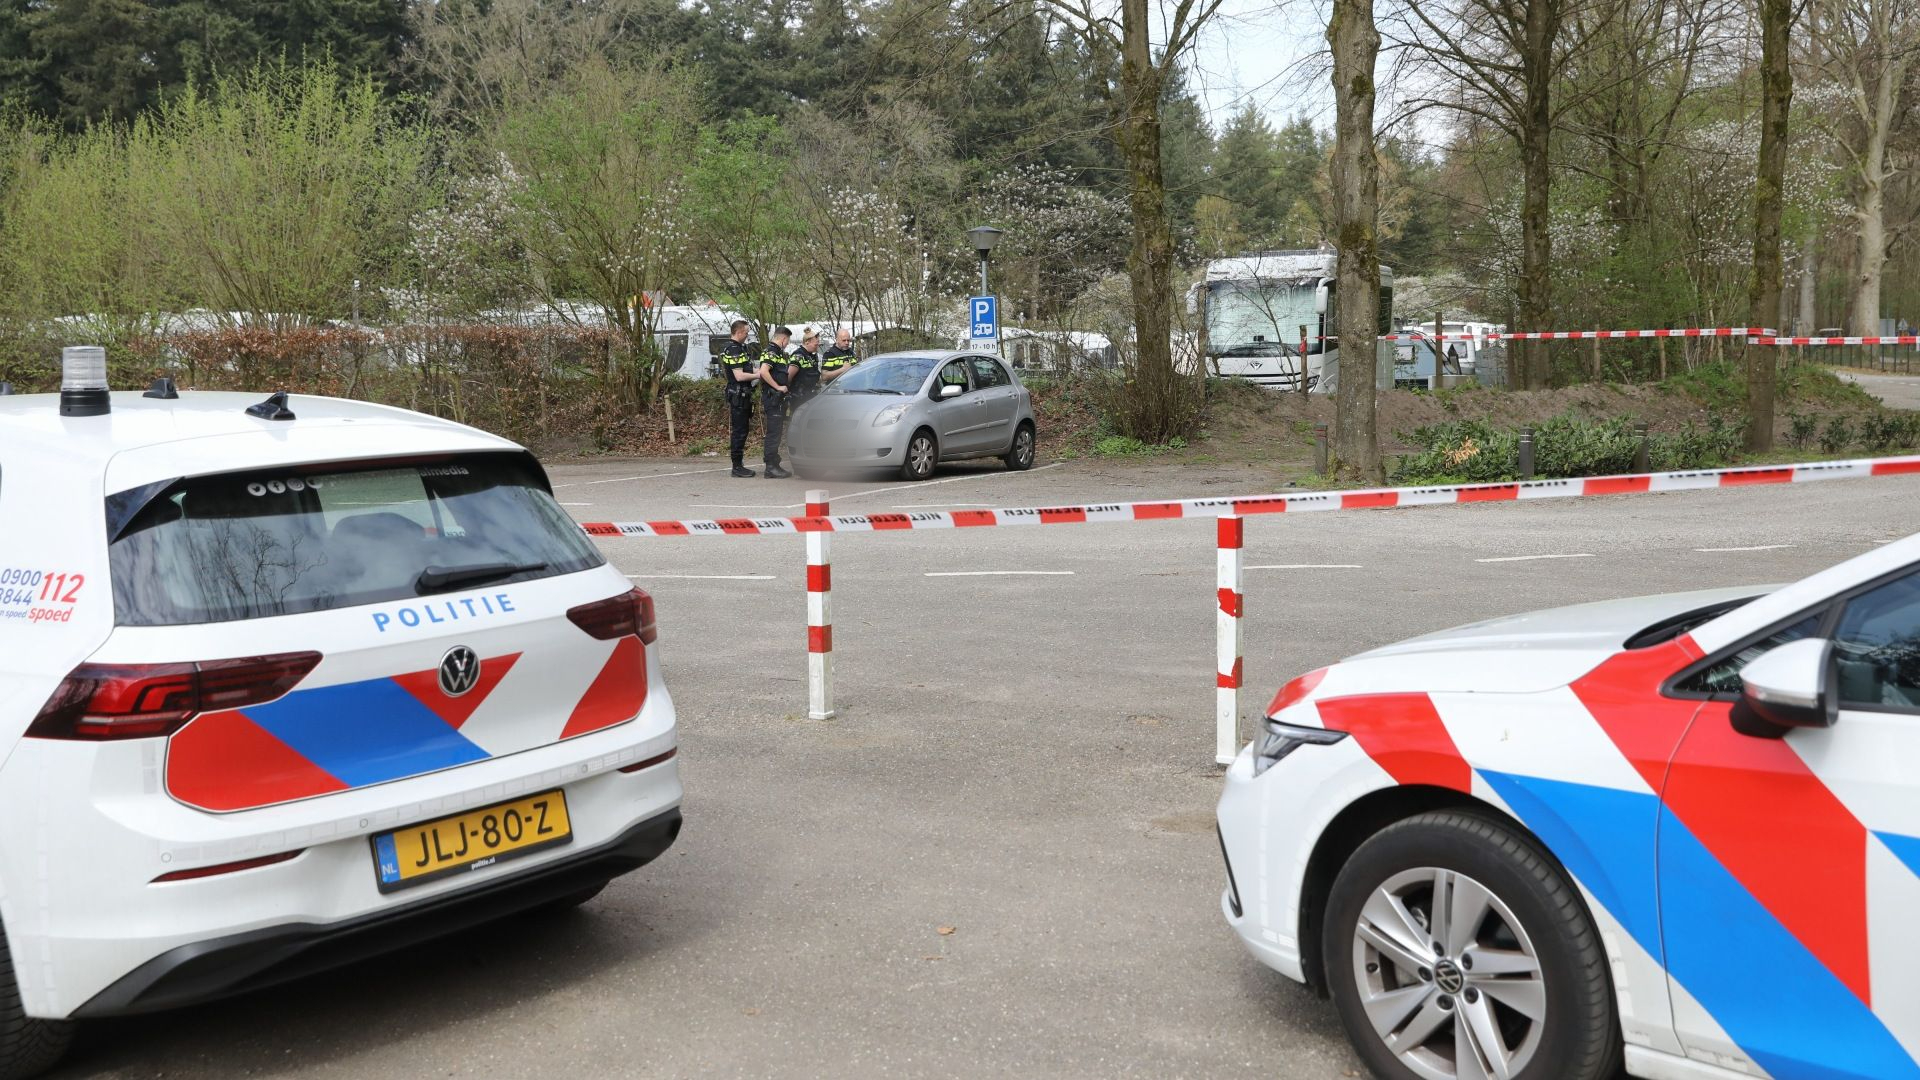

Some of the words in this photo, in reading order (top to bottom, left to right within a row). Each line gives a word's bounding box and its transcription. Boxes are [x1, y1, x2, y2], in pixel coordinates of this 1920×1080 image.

[976, 301, 989, 321] P
[838, 513, 908, 524] BETREDEN
[911, 513, 941, 521] NIET
[620, 525, 646, 533] NIET
[692, 521, 755, 530] BETREDEN
[758, 520, 785, 528] NIET
[583, 526, 619, 535] BETRE
[1, 568, 42, 587] 0900
[40, 572, 85, 603] 112
[6, 609, 28, 619] spoed
[28, 606, 74, 623] spoed
[372, 594, 516, 632] POLITIE
[415, 800, 553, 868] JLJ-80-Z
[382, 862, 398, 876] NL
